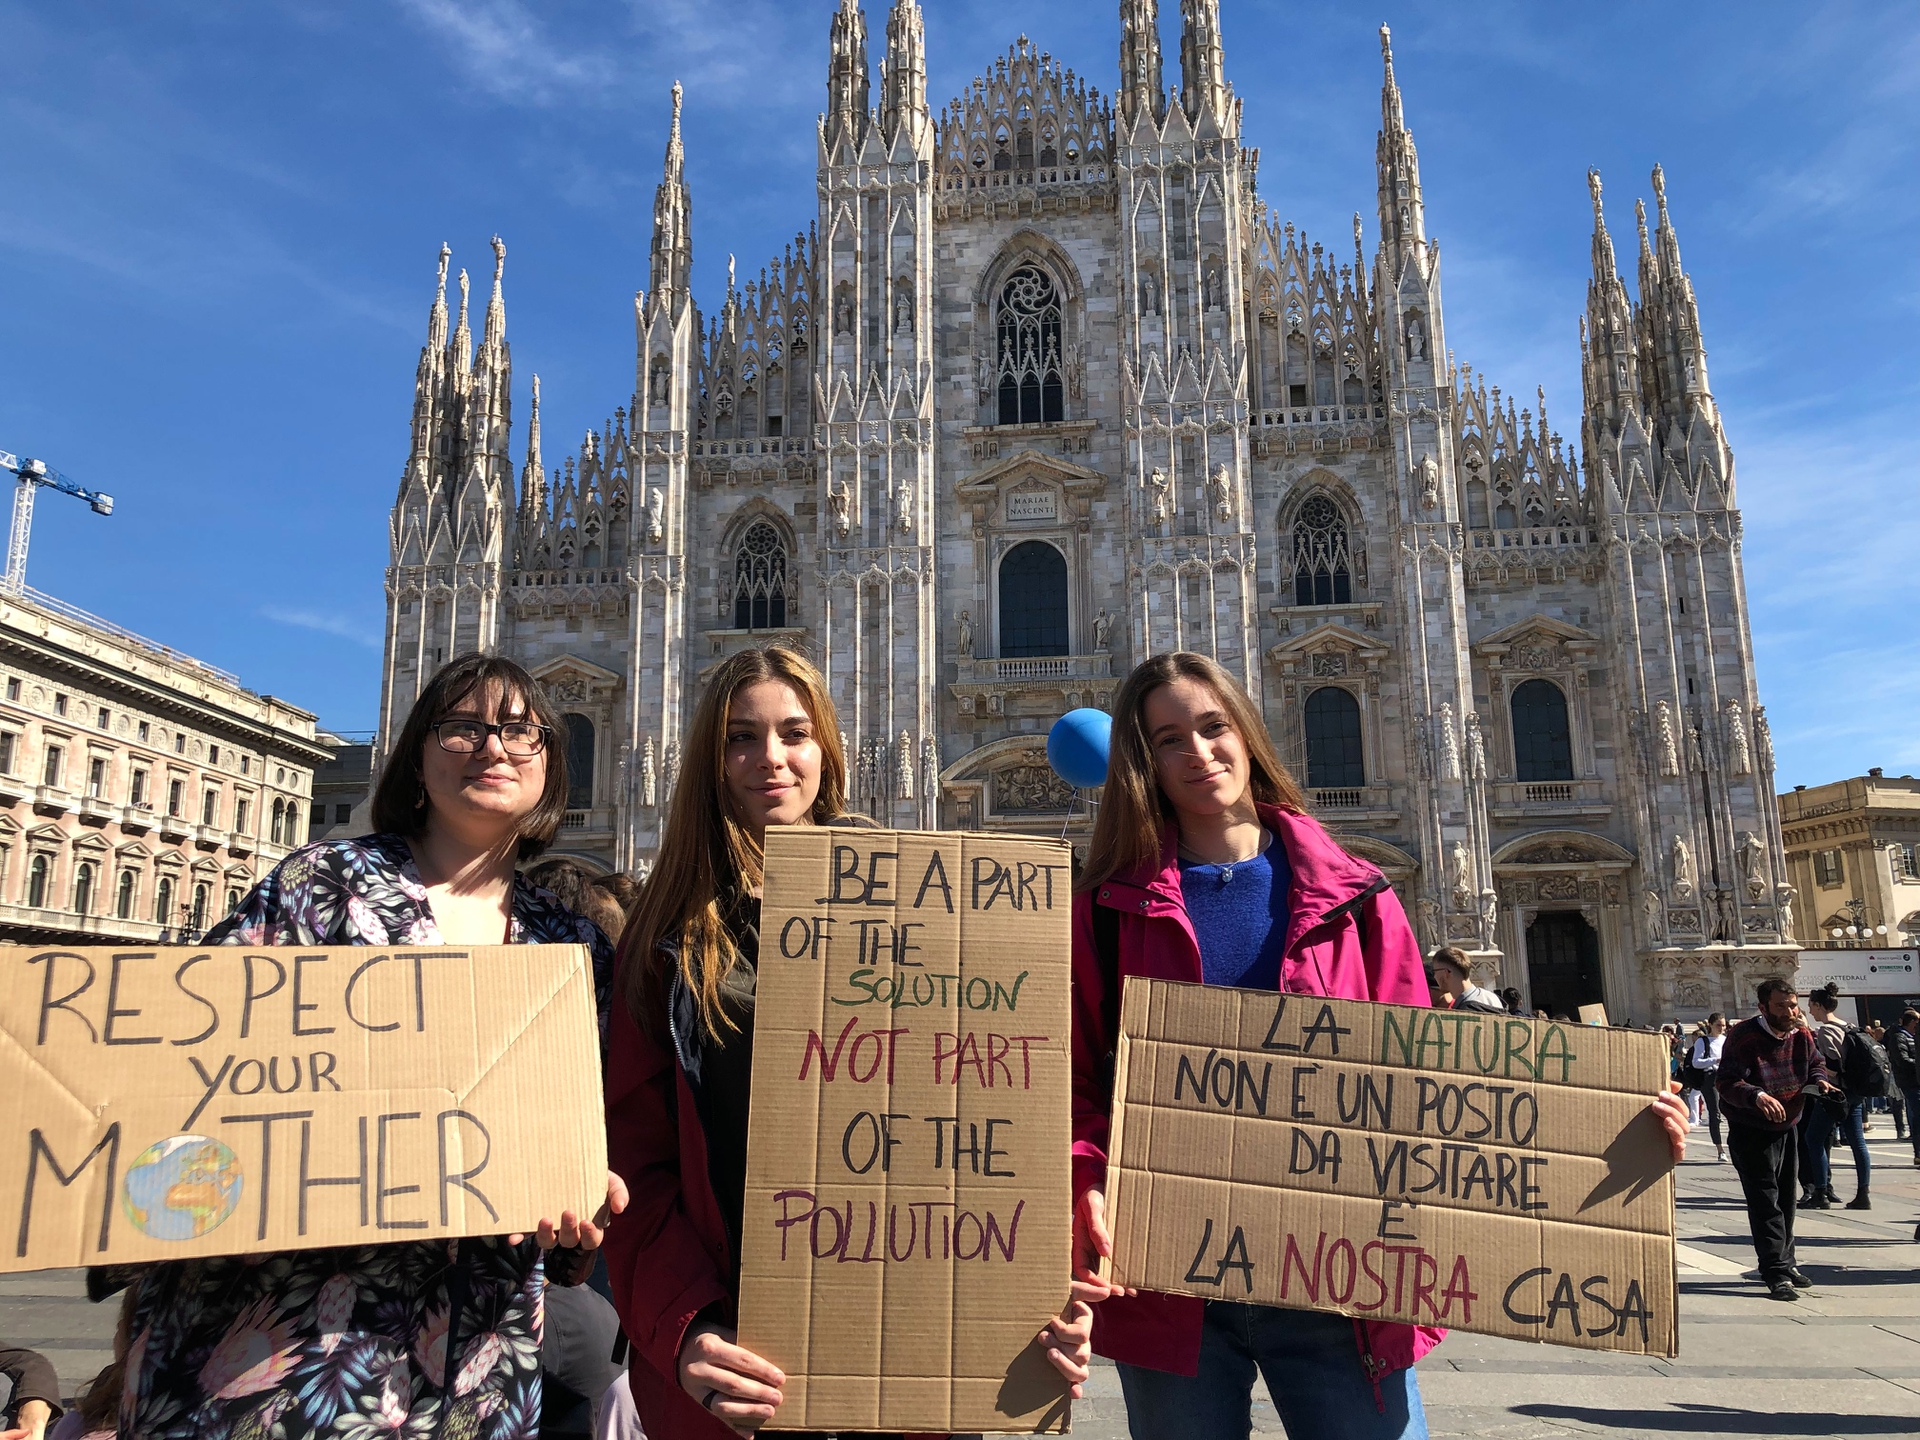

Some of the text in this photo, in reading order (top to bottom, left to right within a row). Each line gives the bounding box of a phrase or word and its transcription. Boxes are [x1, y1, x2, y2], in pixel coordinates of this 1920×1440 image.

[1011, 507, 1053, 515] NASCENTI
[1014, 497, 1048, 505] MARIAE
[814, 845, 1070, 913] BE A PART
[779, 916, 926, 967] OF THE
[27, 952, 469, 1046] RESPECT
[830, 963, 1029, 1012] SOLUTION
[798, 1016, 1050, 1090] NOT PART
[1261, 996, 1577, 1082] LA NATURA
[181, 1051, 341, 1132] YOUR
[1174, 1048, 1273, 1116] NON
[1337, 1073, 1394, 1131] UN
[1415, 1076, 1539, 1147] POSTO
[842, 1111, 1016, 1177] OF THE
[1289, 1127, 1549, 1211] DA VISITARE
[773, 1186, 1026, 1264] POLLUTION
[1184, 1218, 1654, 1344] LA NOSTRA CASA
